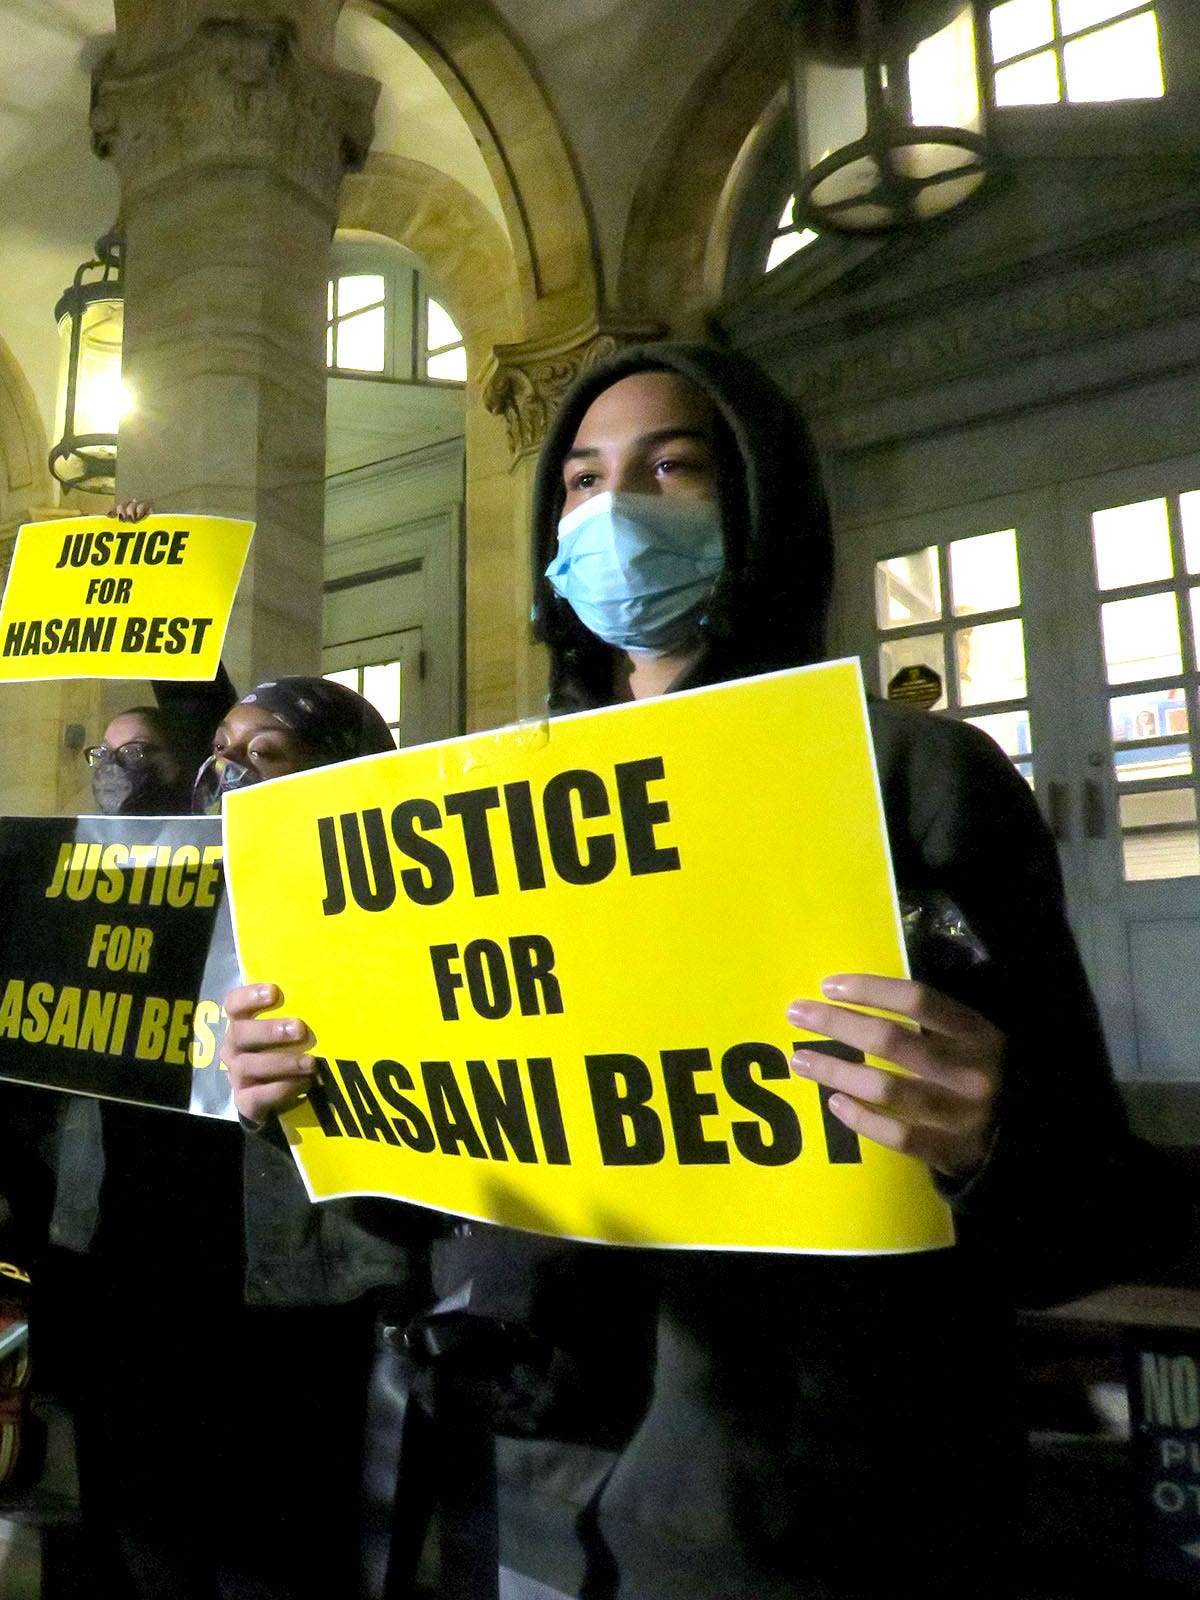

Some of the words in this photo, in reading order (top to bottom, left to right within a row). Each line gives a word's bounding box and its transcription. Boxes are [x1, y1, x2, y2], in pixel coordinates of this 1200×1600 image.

[55, 530, 190, 569] JUSTICE
[85, 577, 133, 605] FOR
[2, 616, 118, 657] HASANI
[120, 616, 213, 655] BEST
[317, 756, 682, 916] JUSTICE
[45, 842, 223, 908] JUSTICE
[87, 923, 154, 973] FOR
[429, 934, 565, 1022] FOR
[306, 1056, 572, 1166] HASANI
